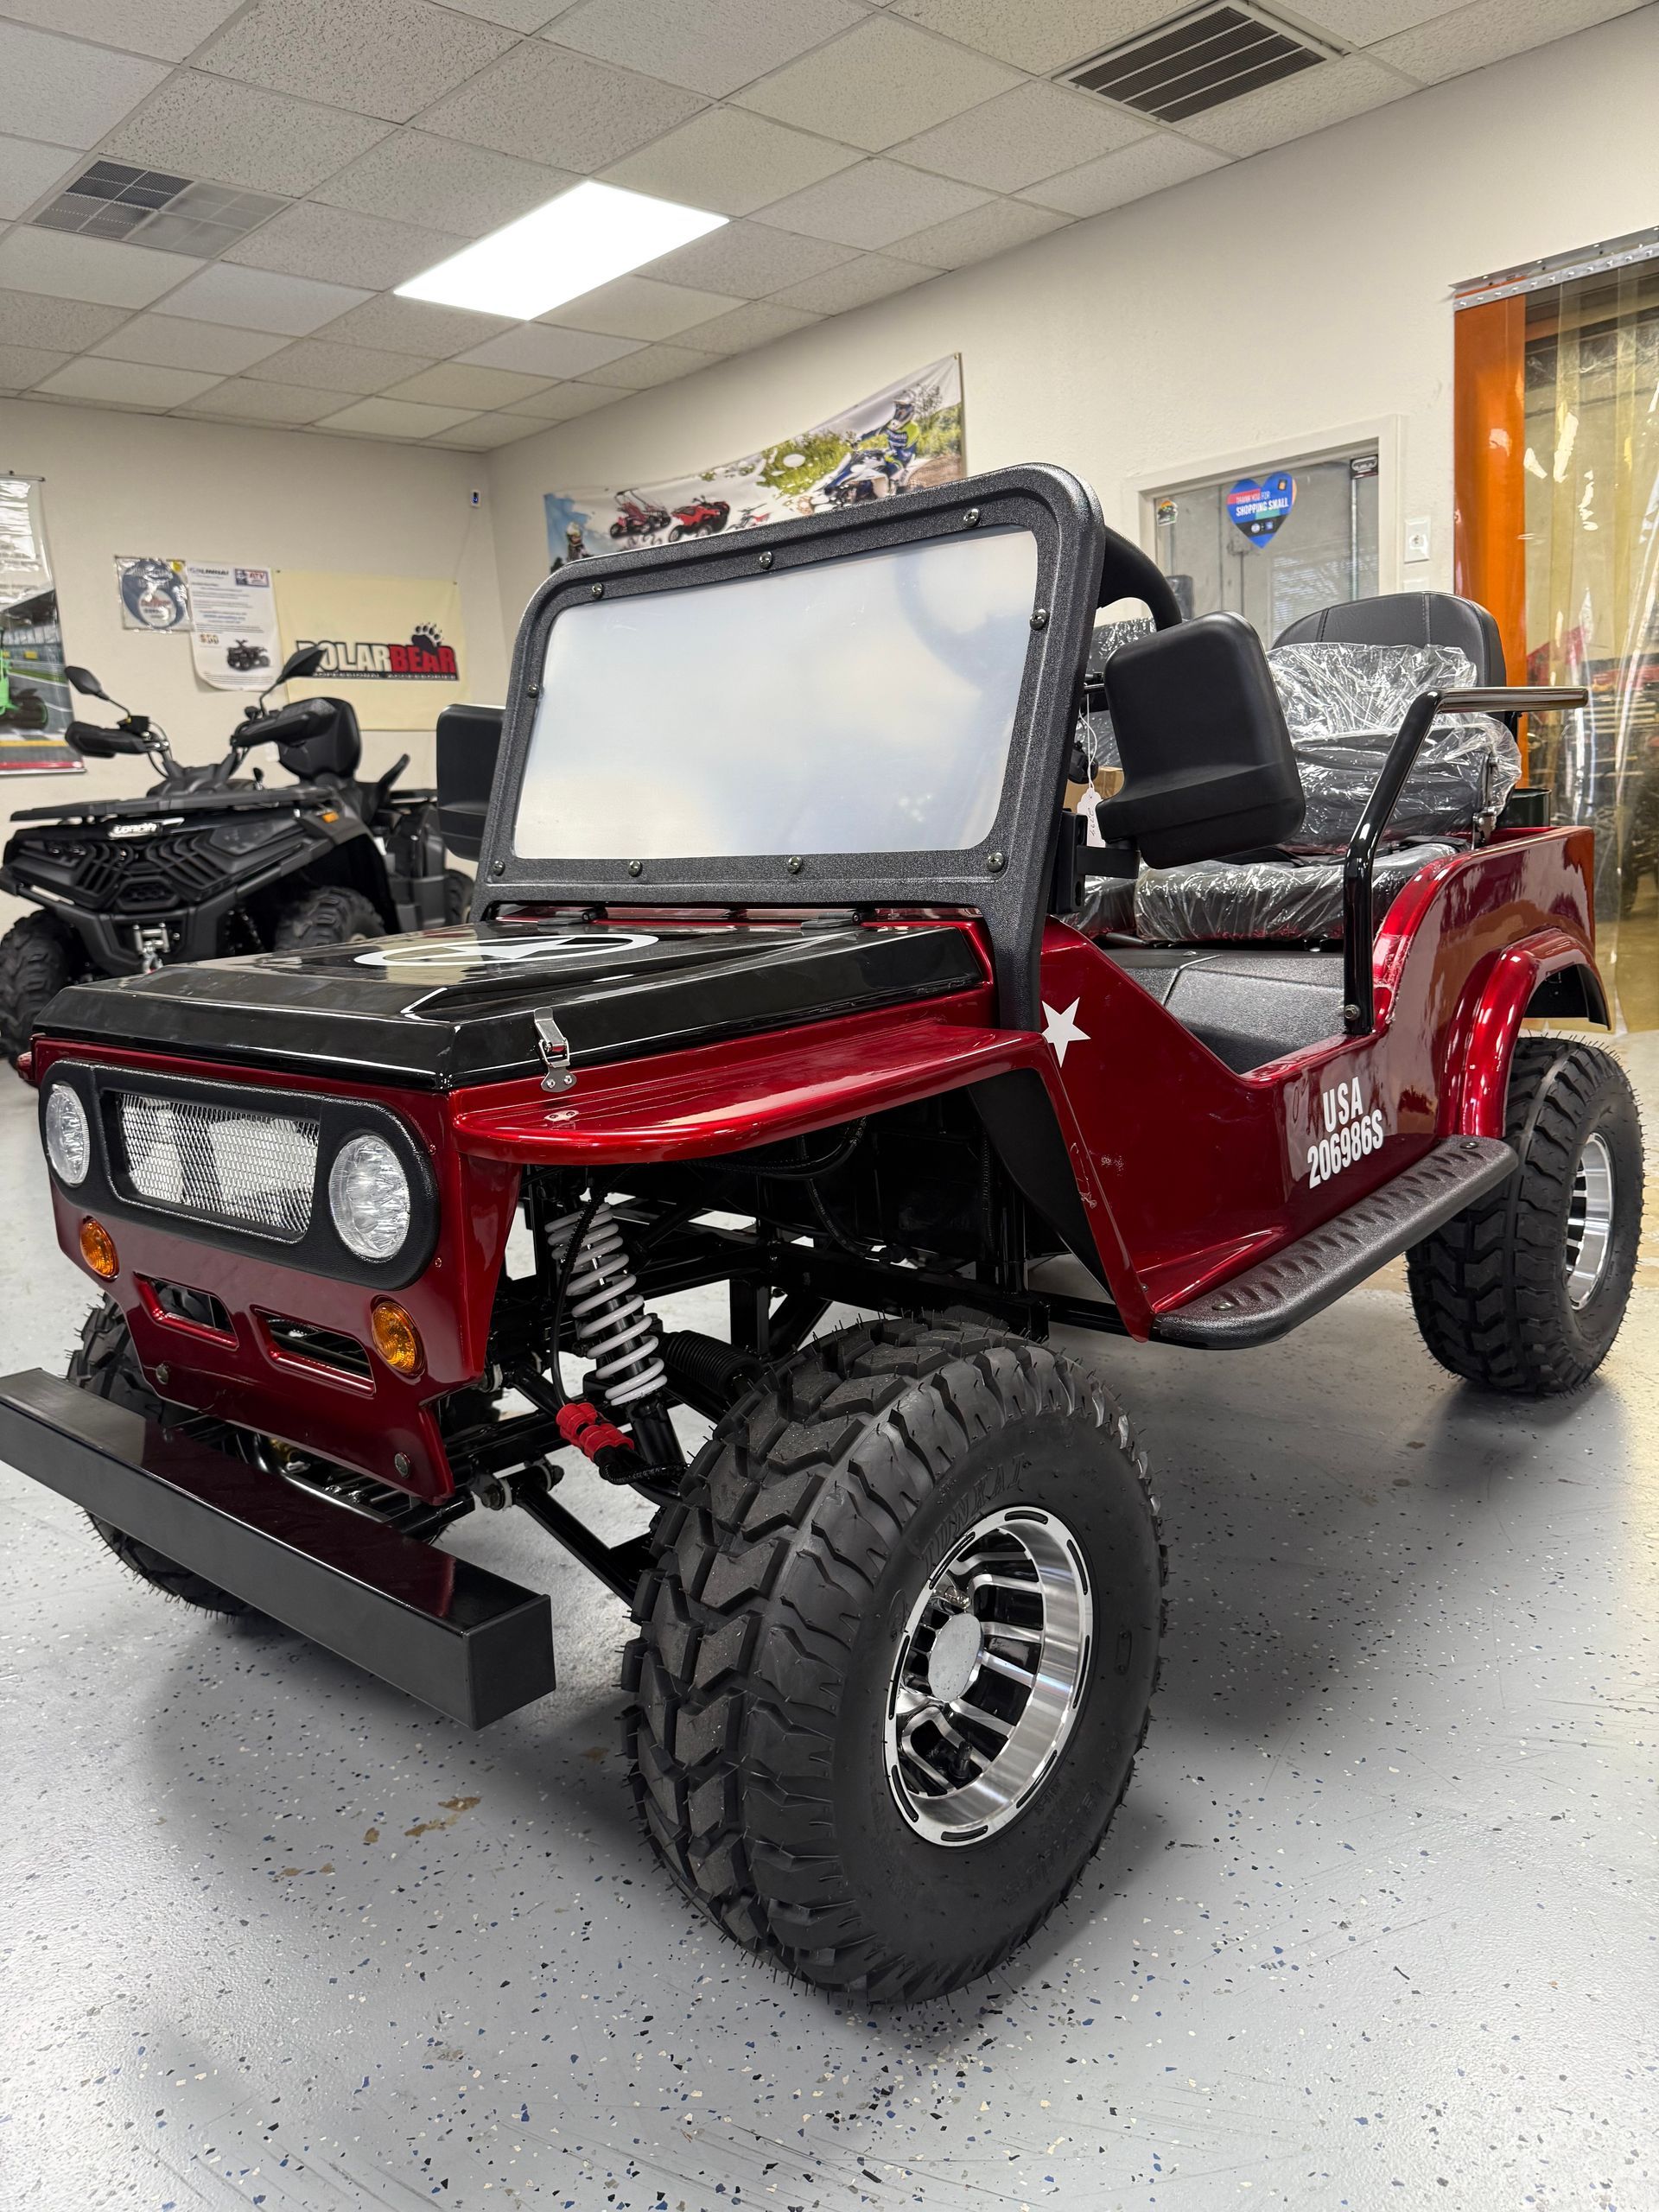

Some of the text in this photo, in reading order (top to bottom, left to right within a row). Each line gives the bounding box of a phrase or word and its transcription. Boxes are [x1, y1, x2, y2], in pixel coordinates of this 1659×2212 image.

[1236, 497, 1289, 517] SHOPPING SMALL
[1323, 1077, 1363, 1132] USA
[1307, 1109, 1383, 1189] 206986S
